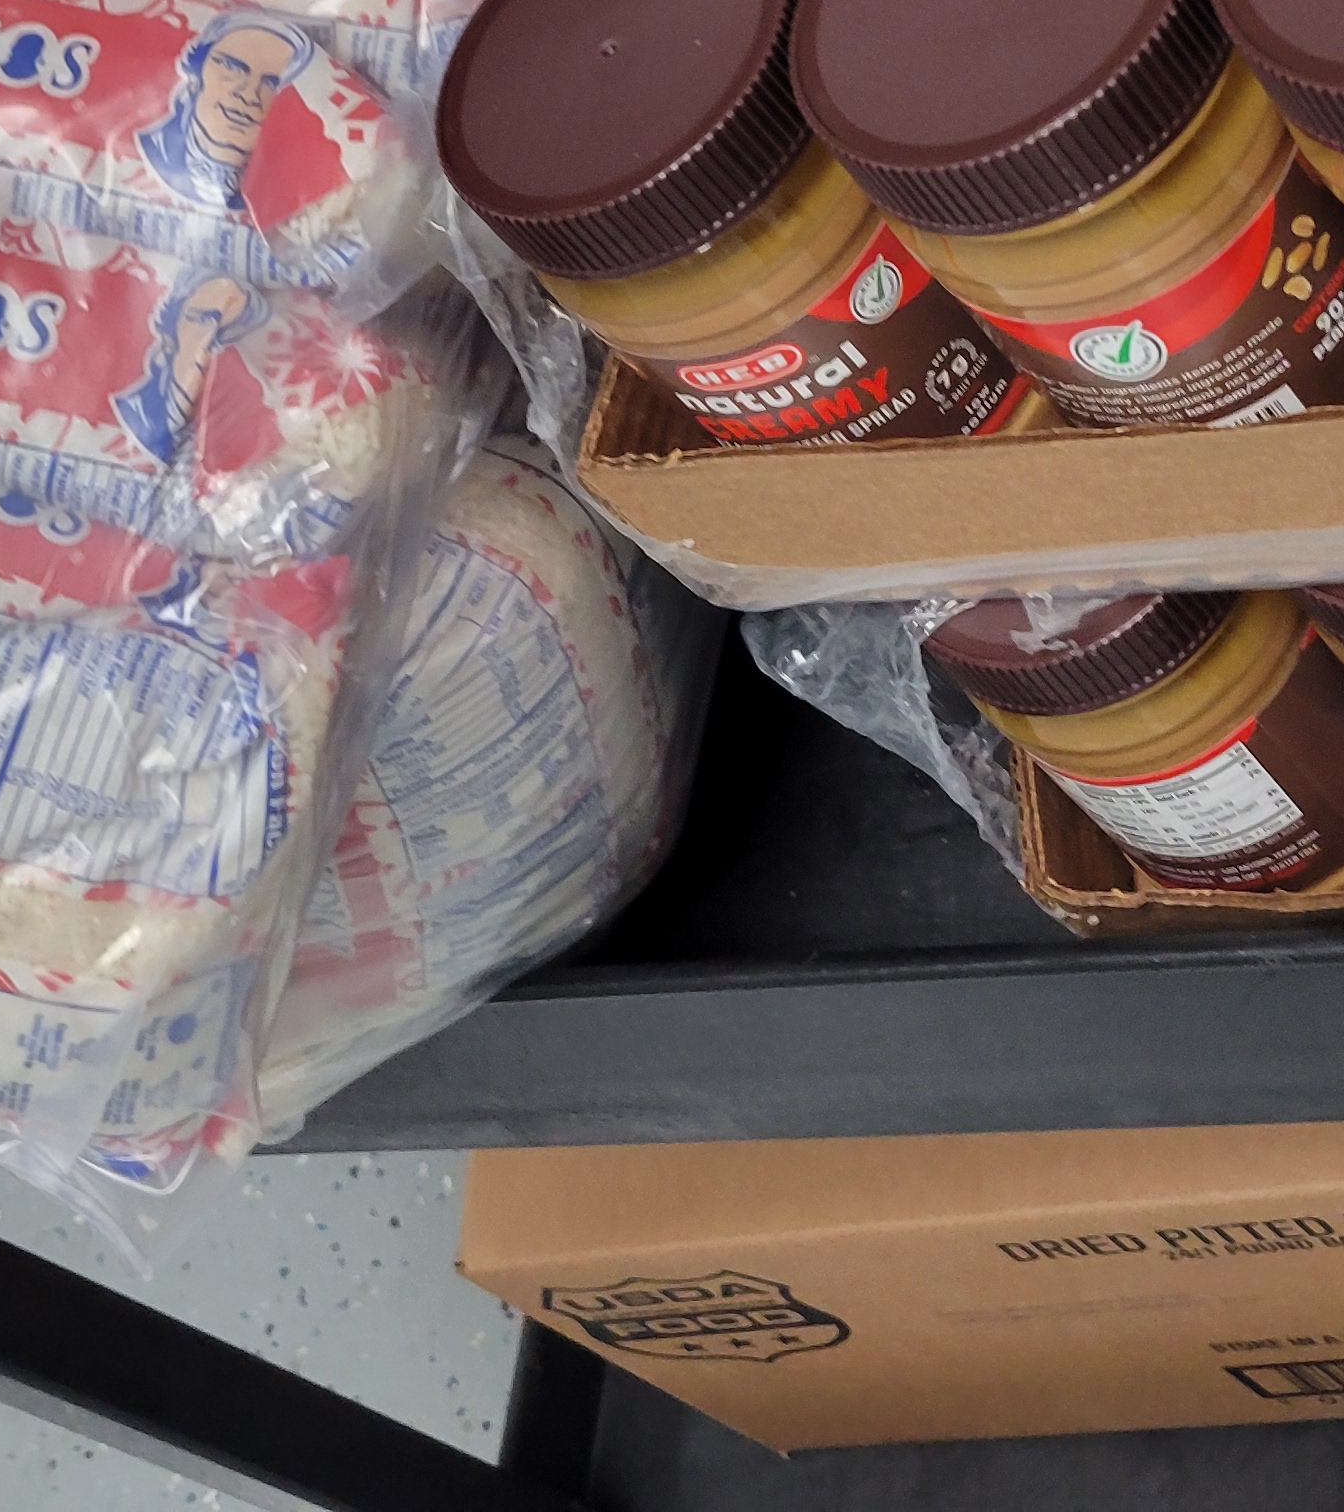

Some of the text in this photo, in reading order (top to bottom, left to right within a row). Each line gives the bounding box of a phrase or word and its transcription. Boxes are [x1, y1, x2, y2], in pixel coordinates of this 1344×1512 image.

[1247, 316, 1283, 348] made
[674, 339, 868, 416] natural
[697, 366, 890, 442] CREAMY
[996, 1230, 1149, 1264] DRIED
[1154, 1214, 1335, 1251] PITTED
[559, 1281, 776, 1319] USDA
[603, 1306, 808, 1339] FOOD
[1324, 1332, 1339, 1345] A
